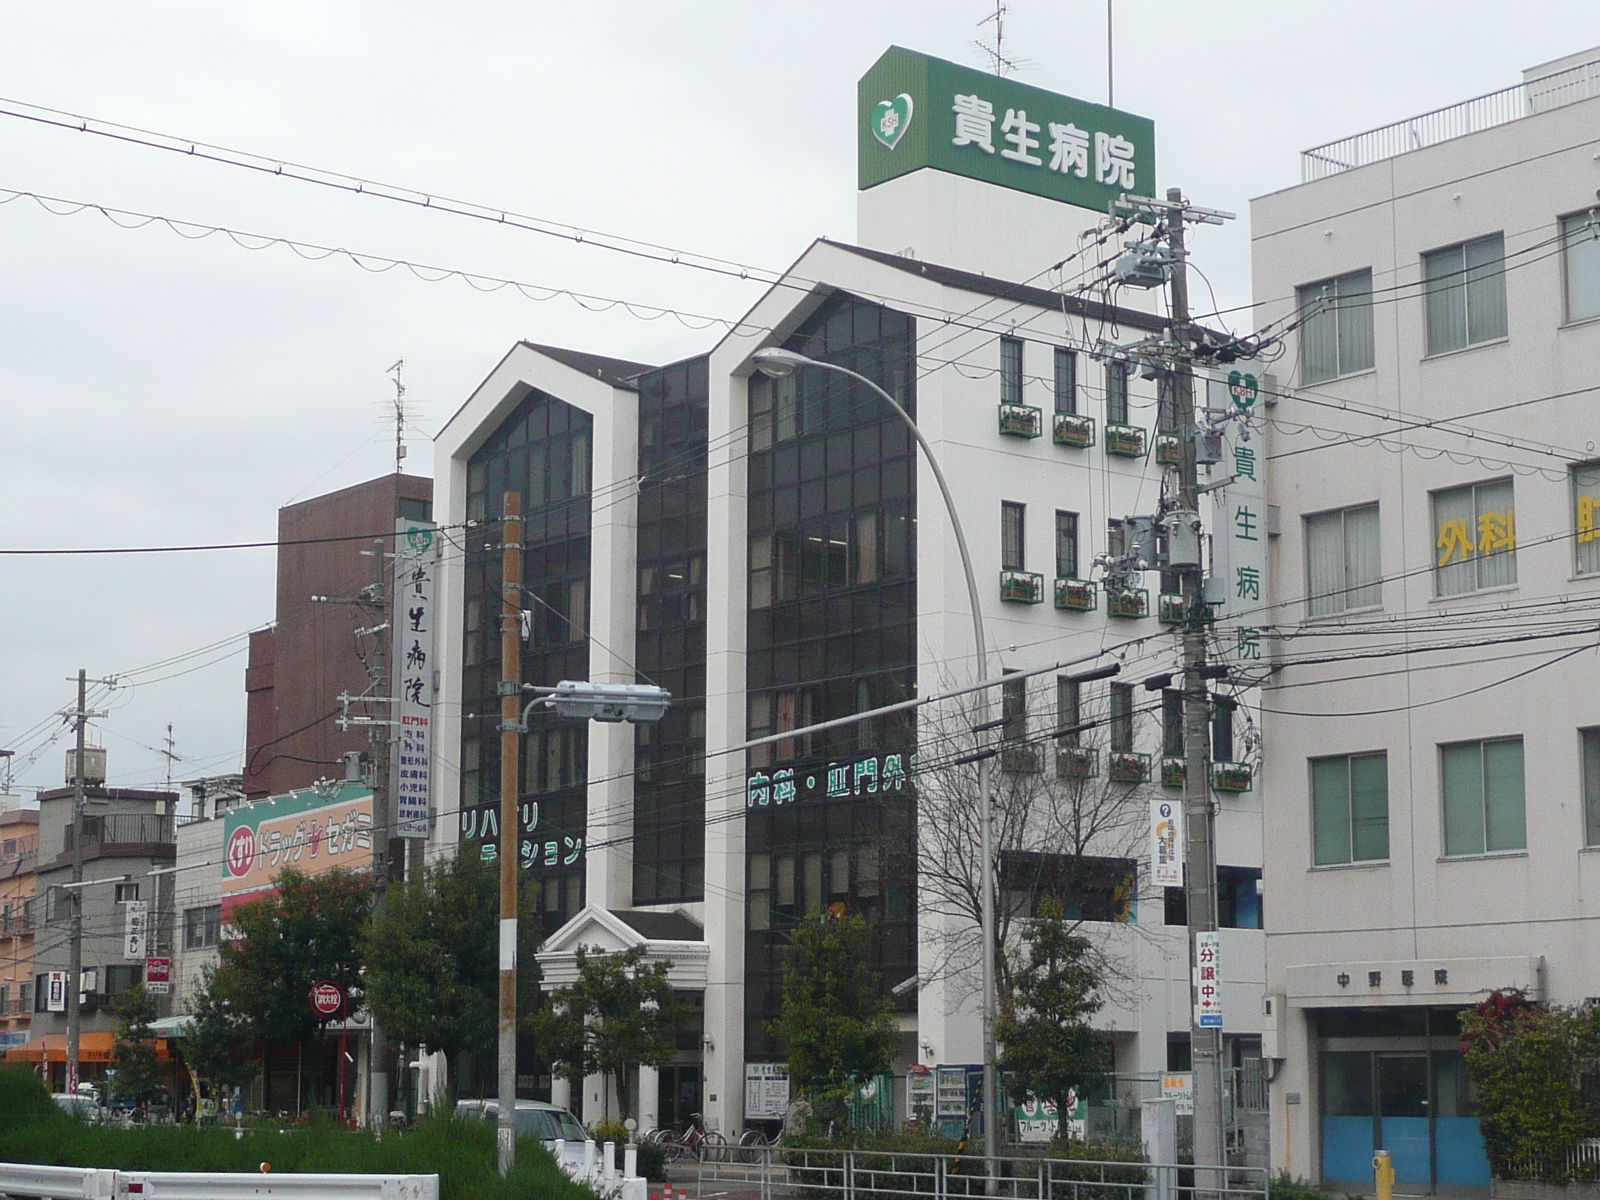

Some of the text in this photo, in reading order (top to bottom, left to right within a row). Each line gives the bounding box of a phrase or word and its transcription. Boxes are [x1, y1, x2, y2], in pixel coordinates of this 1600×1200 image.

[881, 114, 899, 130] KSH
[951, 93, 1135, 190] 貴生病院
[412, 535, 430, 545] KSH
[1436, 509, 1516, 567] 外科
[1234, 445, 1262, 661] 貴生病院
[402, 716, 428, 727] 肛門科
[404, 729, 425, 741] 内科
[400, 756, 428, 767] 整形外科
[400, 769, 427, 780] 皮膚科
[400, 783, 427, 793] 小児科
[399, 796, 427, 807] 胃腸科
[259, 810, 372, 870] ドラッグ セガミ
[228, 835, 253, 868] くすり
[1200, 948, 1215, 998] 分譲中
[1337, 969, 1448, 988] 中野医院
[317, 993, 339, 1005] 消火栓
